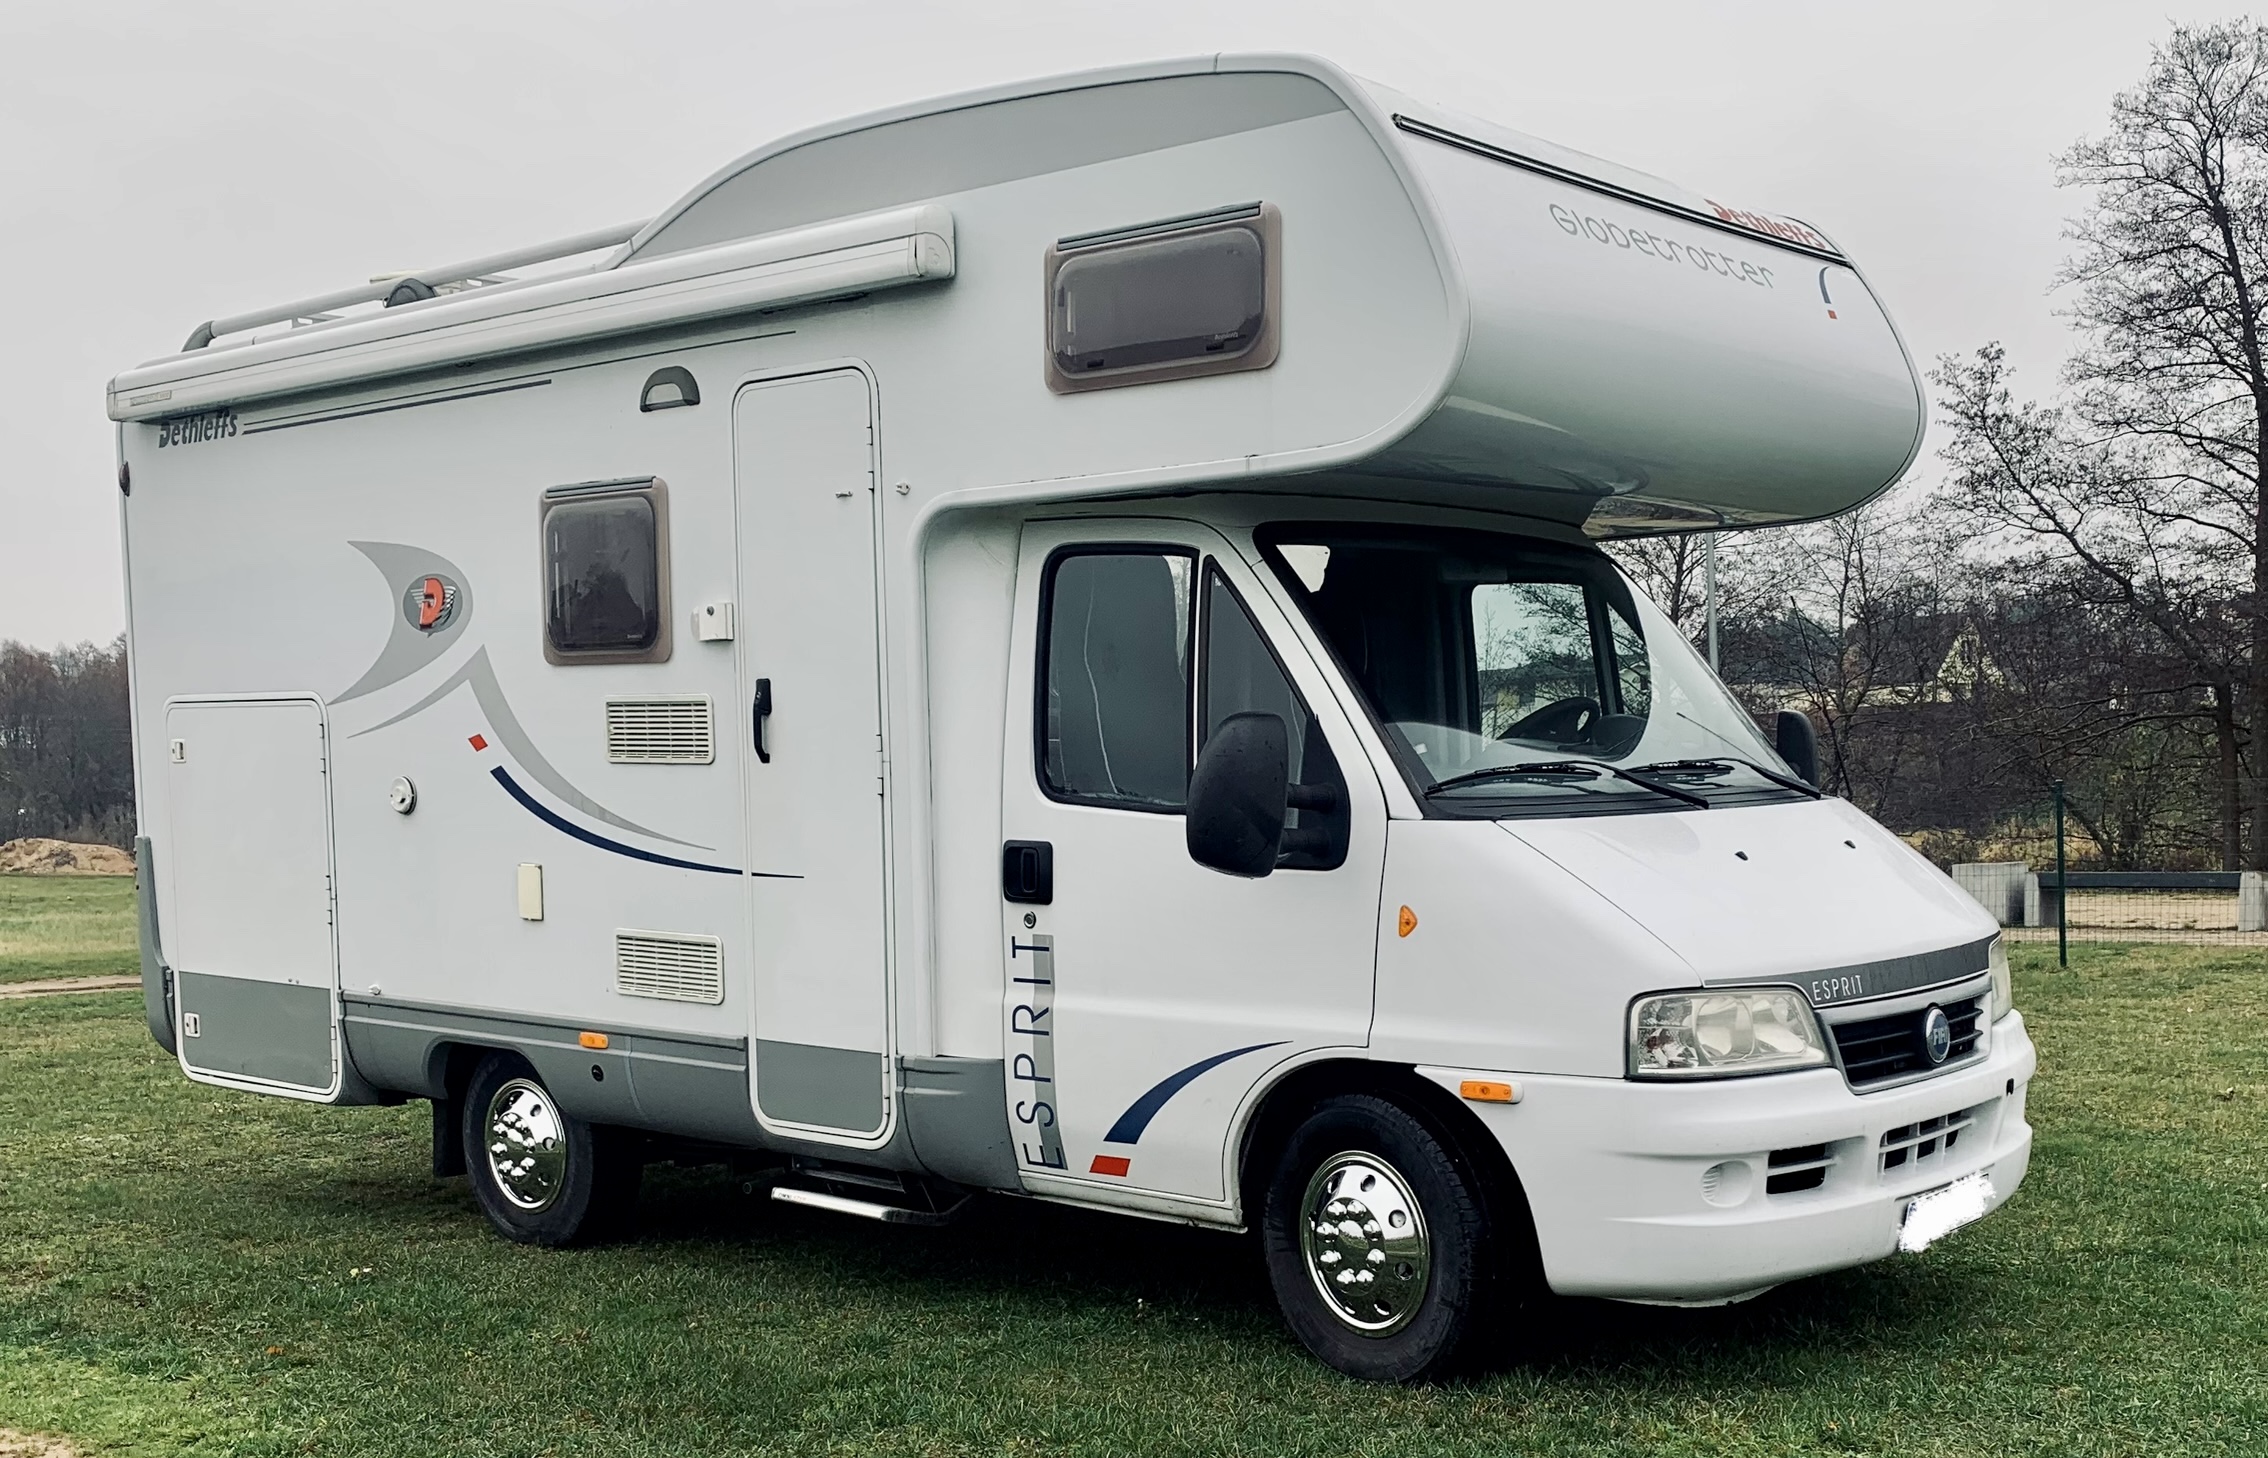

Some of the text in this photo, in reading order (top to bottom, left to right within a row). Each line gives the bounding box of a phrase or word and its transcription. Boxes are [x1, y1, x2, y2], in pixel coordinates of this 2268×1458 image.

[1549, 203, 1774, 288] Globetrotter
[159, 407, 237, 448] Dethleffs
[1812, 974, 1863, 1000] ESPRIT
[1011, 935, 1068, 1169] ESPRIT
